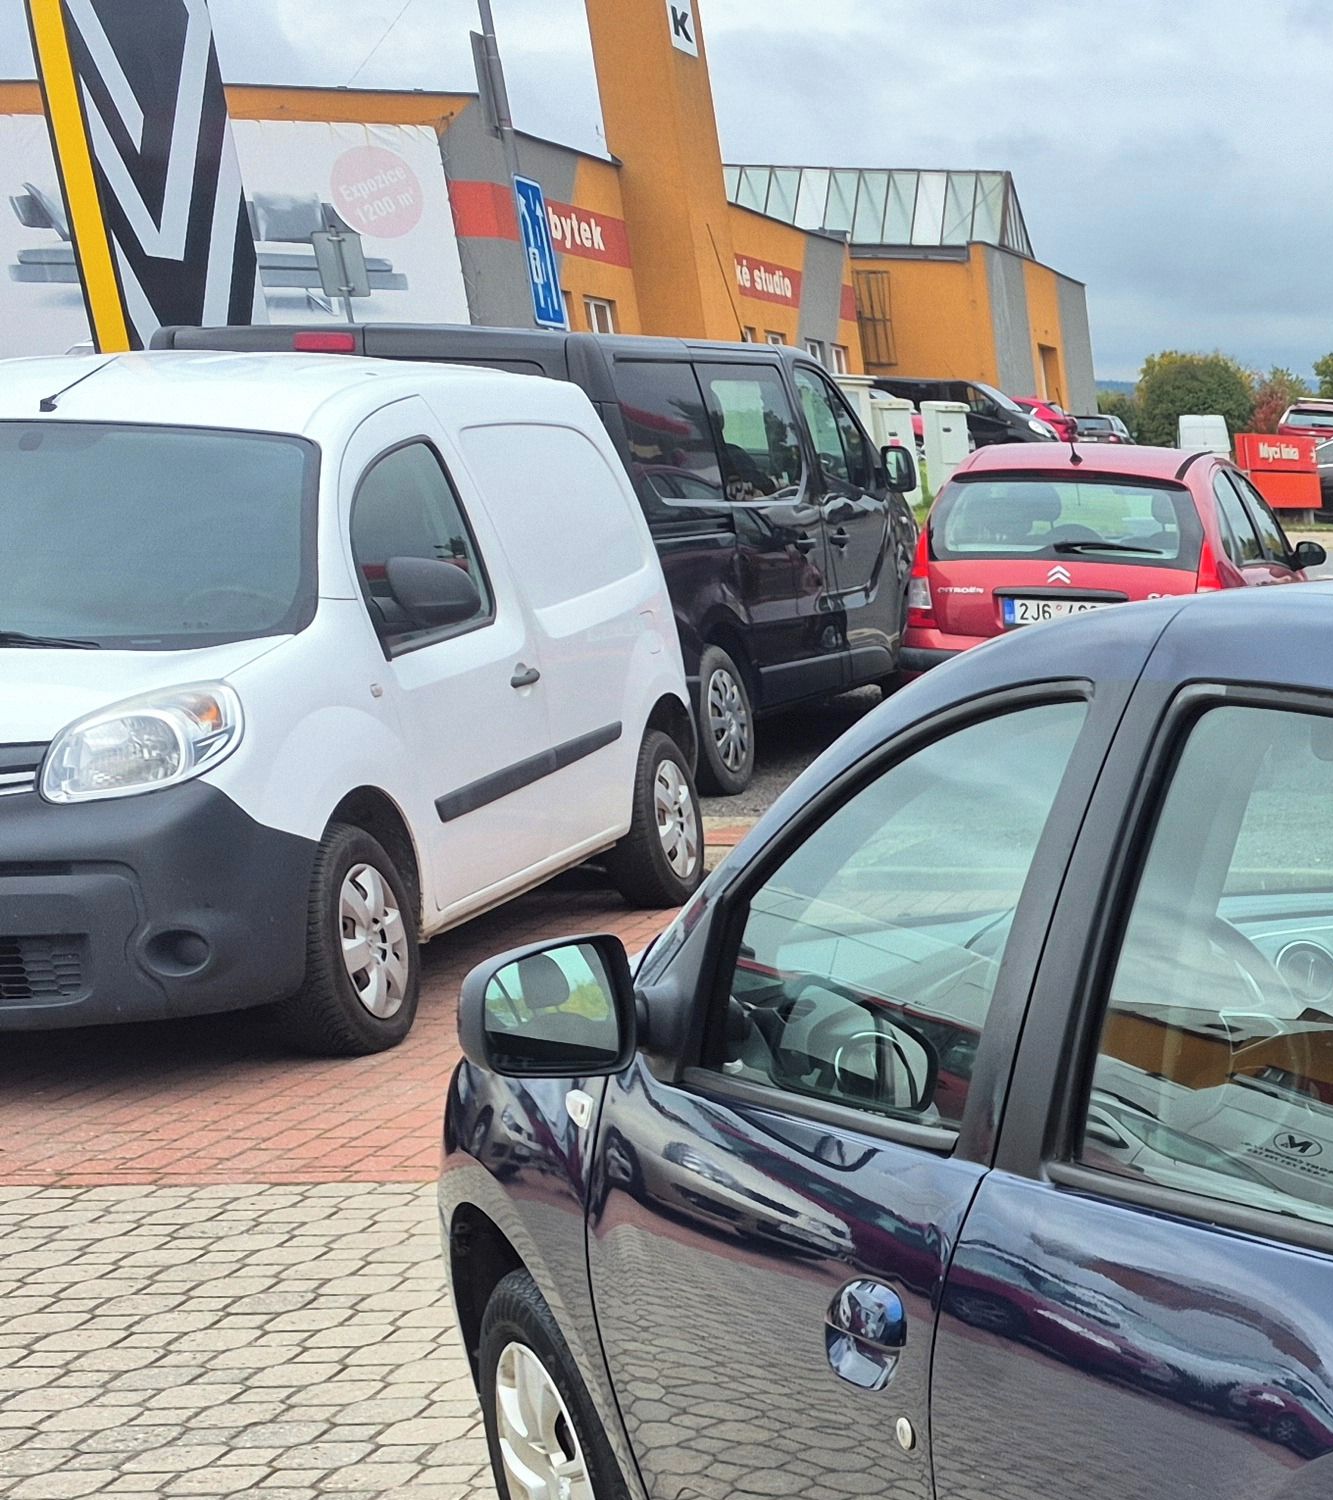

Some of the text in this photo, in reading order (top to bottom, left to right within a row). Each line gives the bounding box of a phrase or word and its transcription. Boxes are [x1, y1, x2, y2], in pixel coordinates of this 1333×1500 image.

[338, 165, 407, 202] Expozice
[355, 195, 396, 223] 1200
[753, 265, 792, 298] studio
[1019, 602, 1052, 621] 2J6
